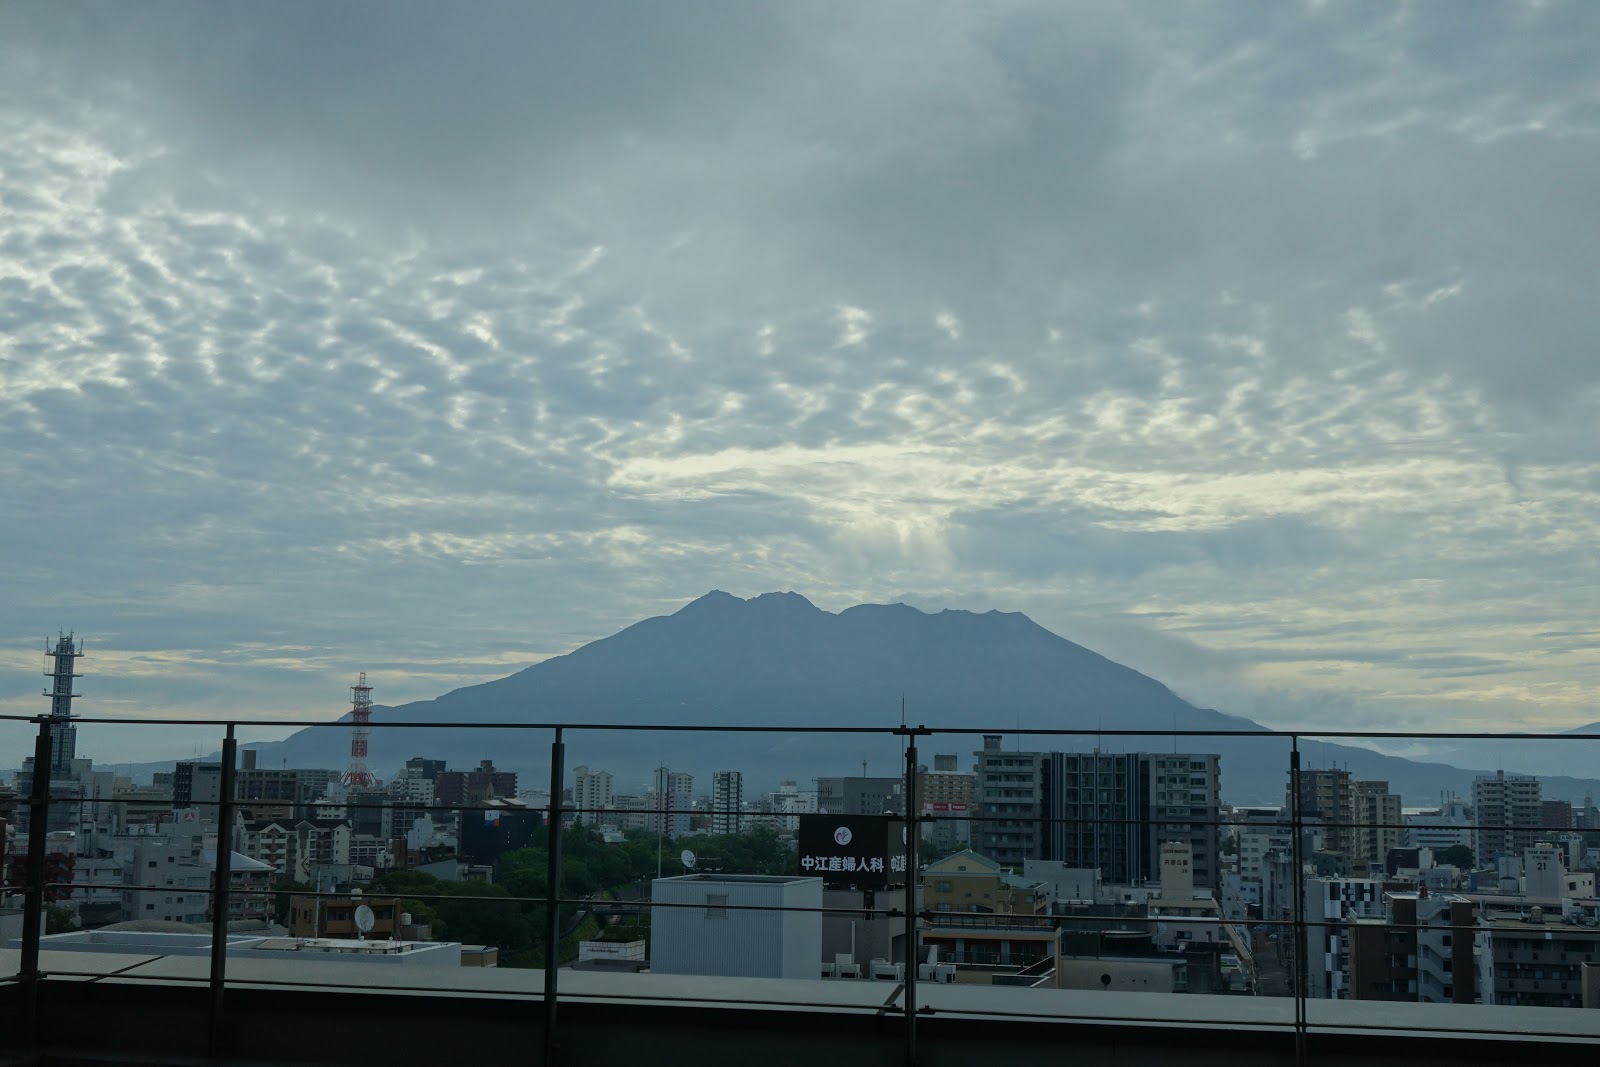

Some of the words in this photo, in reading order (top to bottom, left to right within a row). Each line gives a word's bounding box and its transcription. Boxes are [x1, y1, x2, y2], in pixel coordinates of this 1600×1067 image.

[801, 854, 884, 873] 中江産婦人科
[1537, 862, 1546, 871] 21
